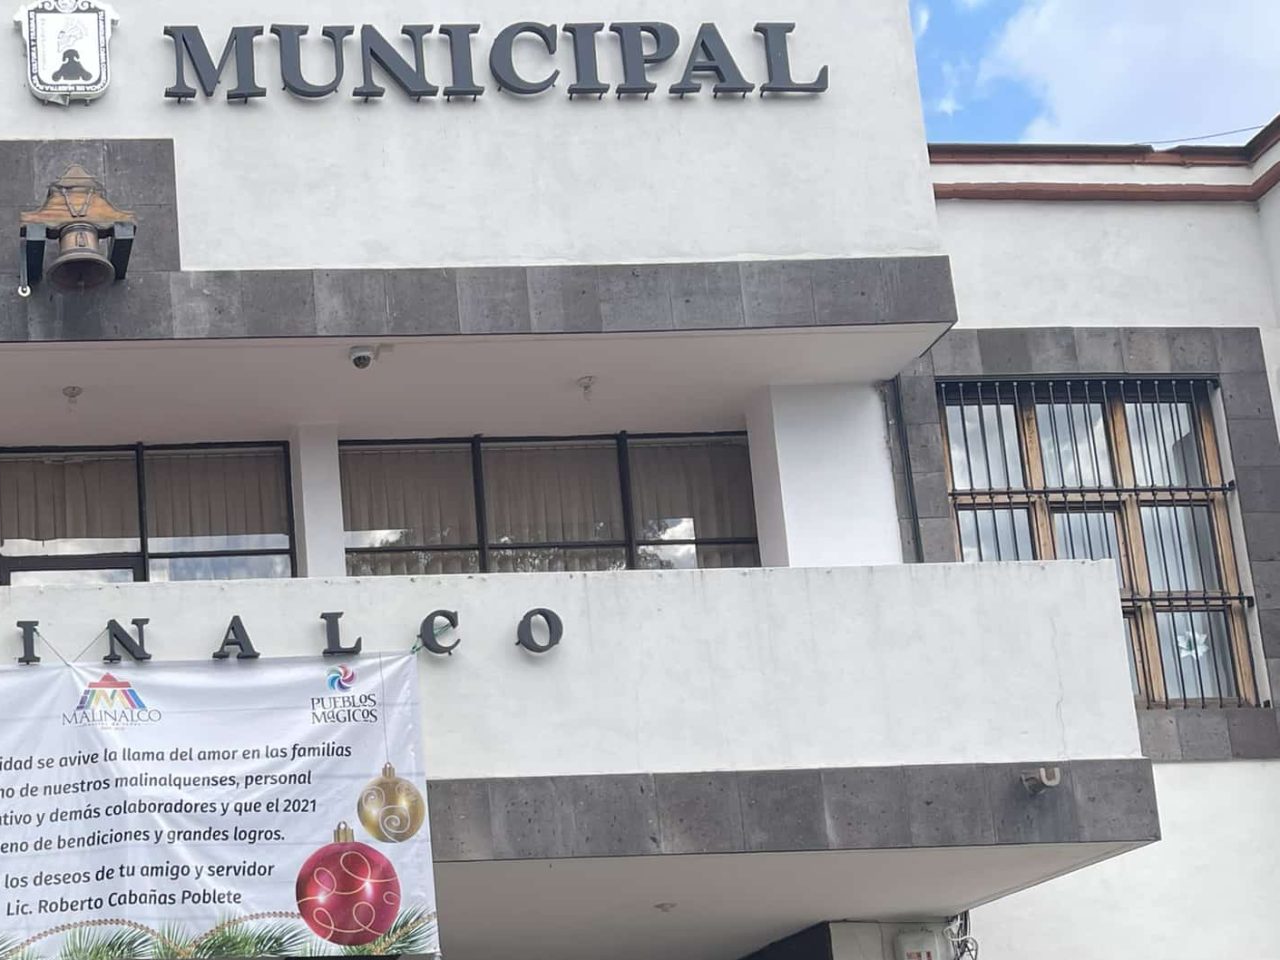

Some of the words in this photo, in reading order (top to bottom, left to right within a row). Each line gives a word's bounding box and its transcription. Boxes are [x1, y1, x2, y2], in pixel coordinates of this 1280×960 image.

[164, 22, 829, 99] MUNICIPAL
[62, 708, 162, 726] MALINALCO
[37, 757, 55, 769] se
[59, 750, 99, 767] avive
[104, 748, 118, 762] la
[122, 748, 165, 762] llama
[170, 748, 193, 762] del
[197, 749, 239, 761] amor
[242, 748, 261, 759] en
[265, 745, 288, 759] las
[290, 741, 352, 762] familias
[20, 783, 39, 797] de
[43, 777, 110, 796] nuestros
[115, 772, 241, 790] malinalquenses,
[244, 770, 312, 788] personal
[36, 811, 45, 826] y
[49, 803, 101, 823] demás
[105, 799, 217, 817] colaboradores
[220, 802, 229, 816] y
[234, 800, 262, 816] que
[266, 798, 279, 813] el
[282, 799, 316, 813] 2021
[33, 836, 52, 851] de
[57, 827, 150, 850] bendiciones
[155, 829, 163, 844] y
[167, 826, 229, 844] grandes
[233, 826, 285, 844] logros.
[4, 873, 28, 889] los
[33, 869, 90, 887] deseos
[95, 865, 114, 881] de
[119, 864, 135, 878] tu
[140, 861, 190, 881] amigo
[194, 865, 204, 879] y
[207, 861, 274, 877] servidor
[6, 900, 33, 916] Lic.
[38, 894, 104, 913] Roberto
[108, 888, 176, 908] Cabañas
[182, 888, 242, 905] Poblete
